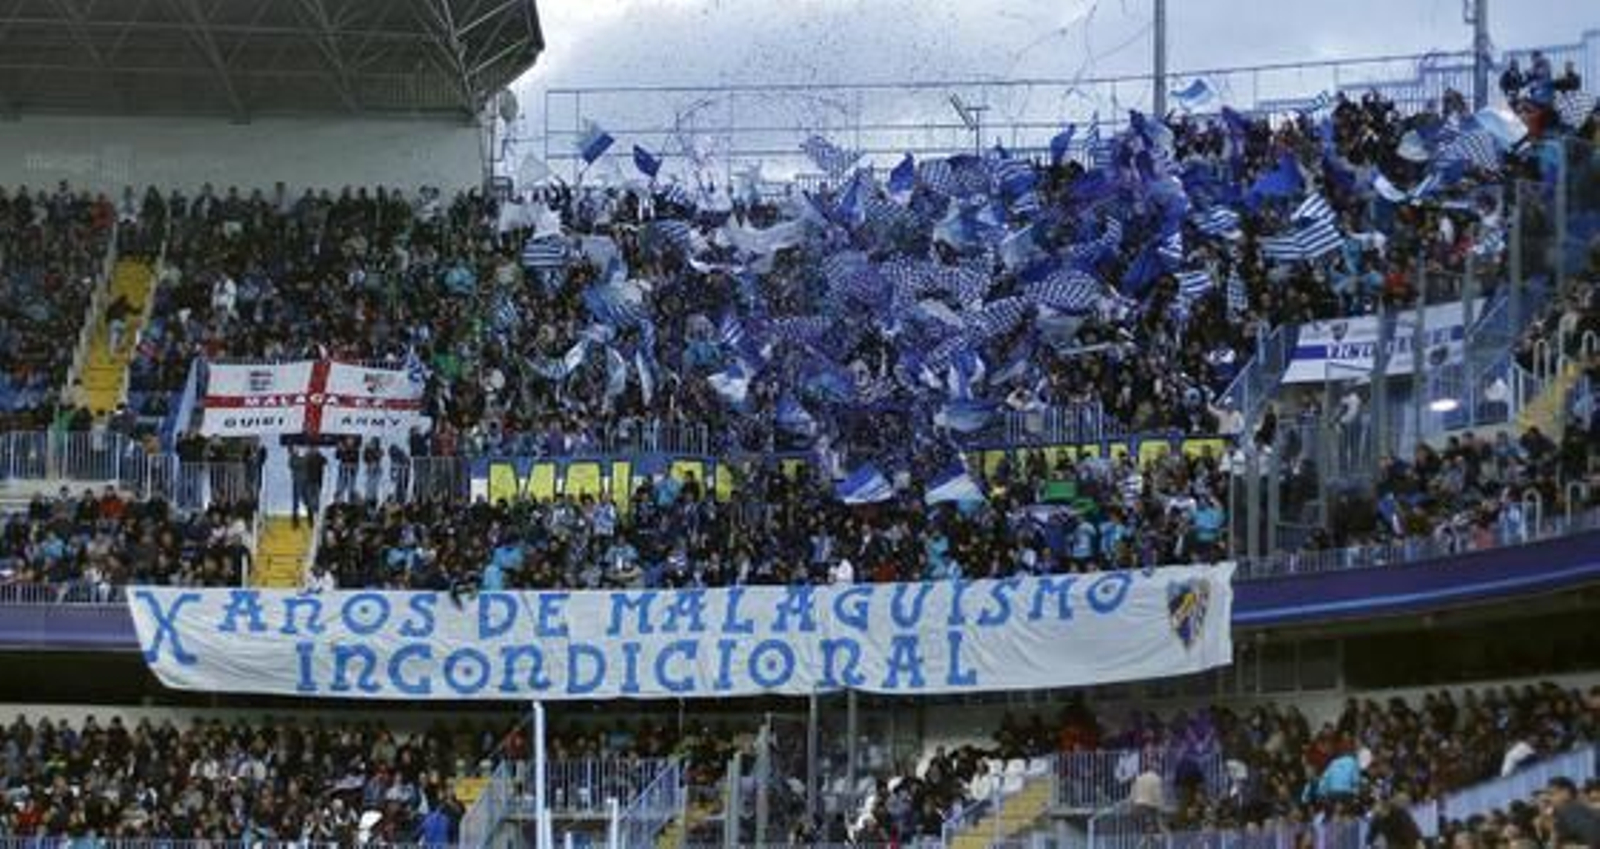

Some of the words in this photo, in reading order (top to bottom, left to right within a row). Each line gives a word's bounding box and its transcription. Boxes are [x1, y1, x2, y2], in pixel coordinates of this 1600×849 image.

[341, 415, 401, 427] ARMY
[135, 590, 202, 666] X
[478, 590, 571, 637] DE
[607, 572, 1132, 635] MALAGUISMO
[296, 631, 977, 694] INCONDICIONAL
